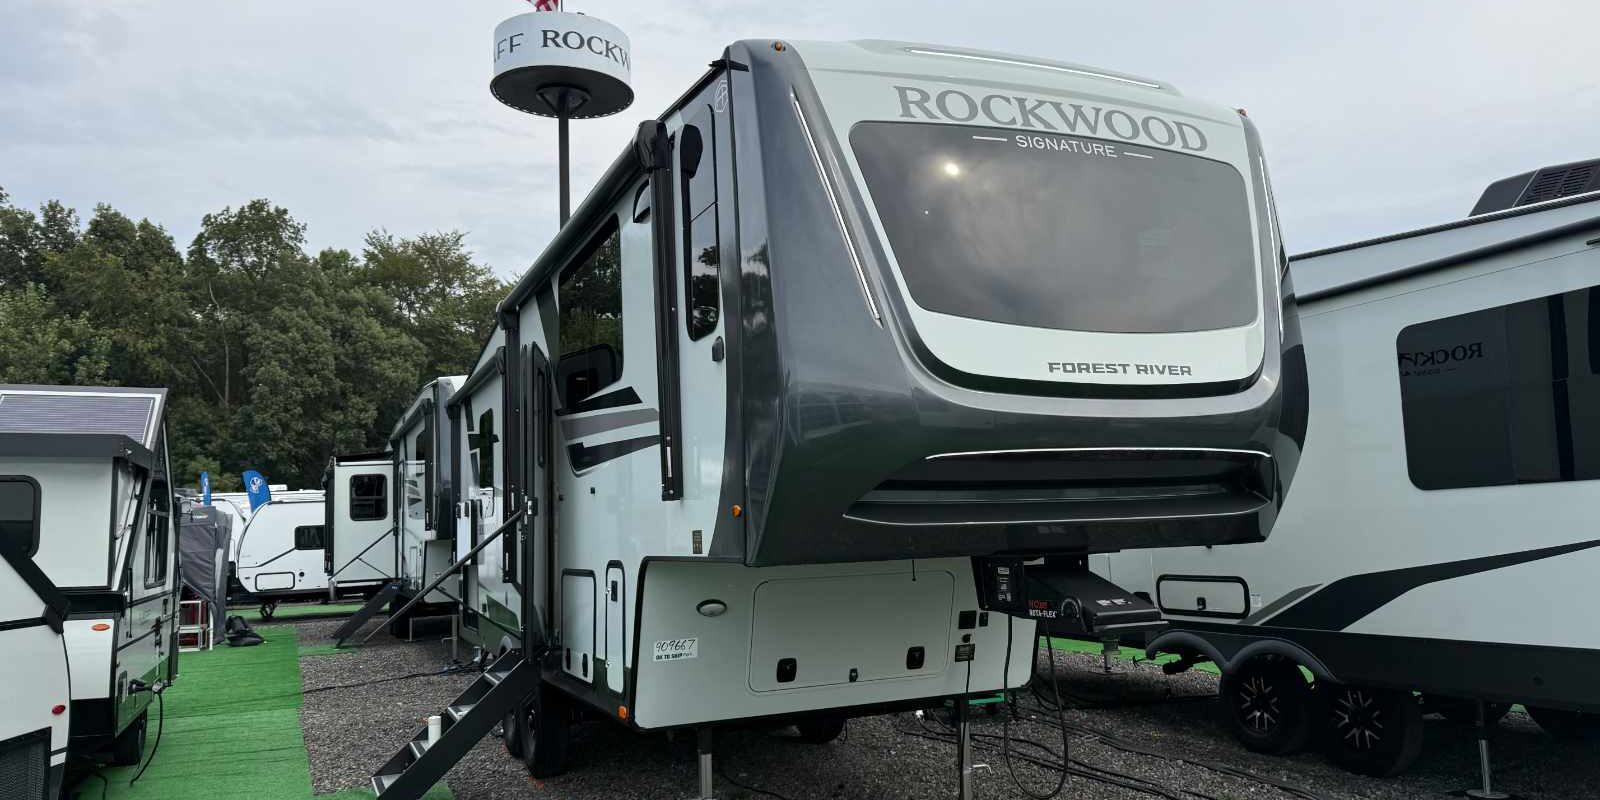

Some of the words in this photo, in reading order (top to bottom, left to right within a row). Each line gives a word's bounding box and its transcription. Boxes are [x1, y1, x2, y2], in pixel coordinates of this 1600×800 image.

[494, 33, 524, 62] FF
[893, 86, 1208, 152] ROCKWOOD
[1015, 135, 1118, 158] SIGNATURE
[1047, 362, 1130, 374] FOREST
[1135, 364, 1193, 376] RIVER
[656, 639, 696, 652] 909667
